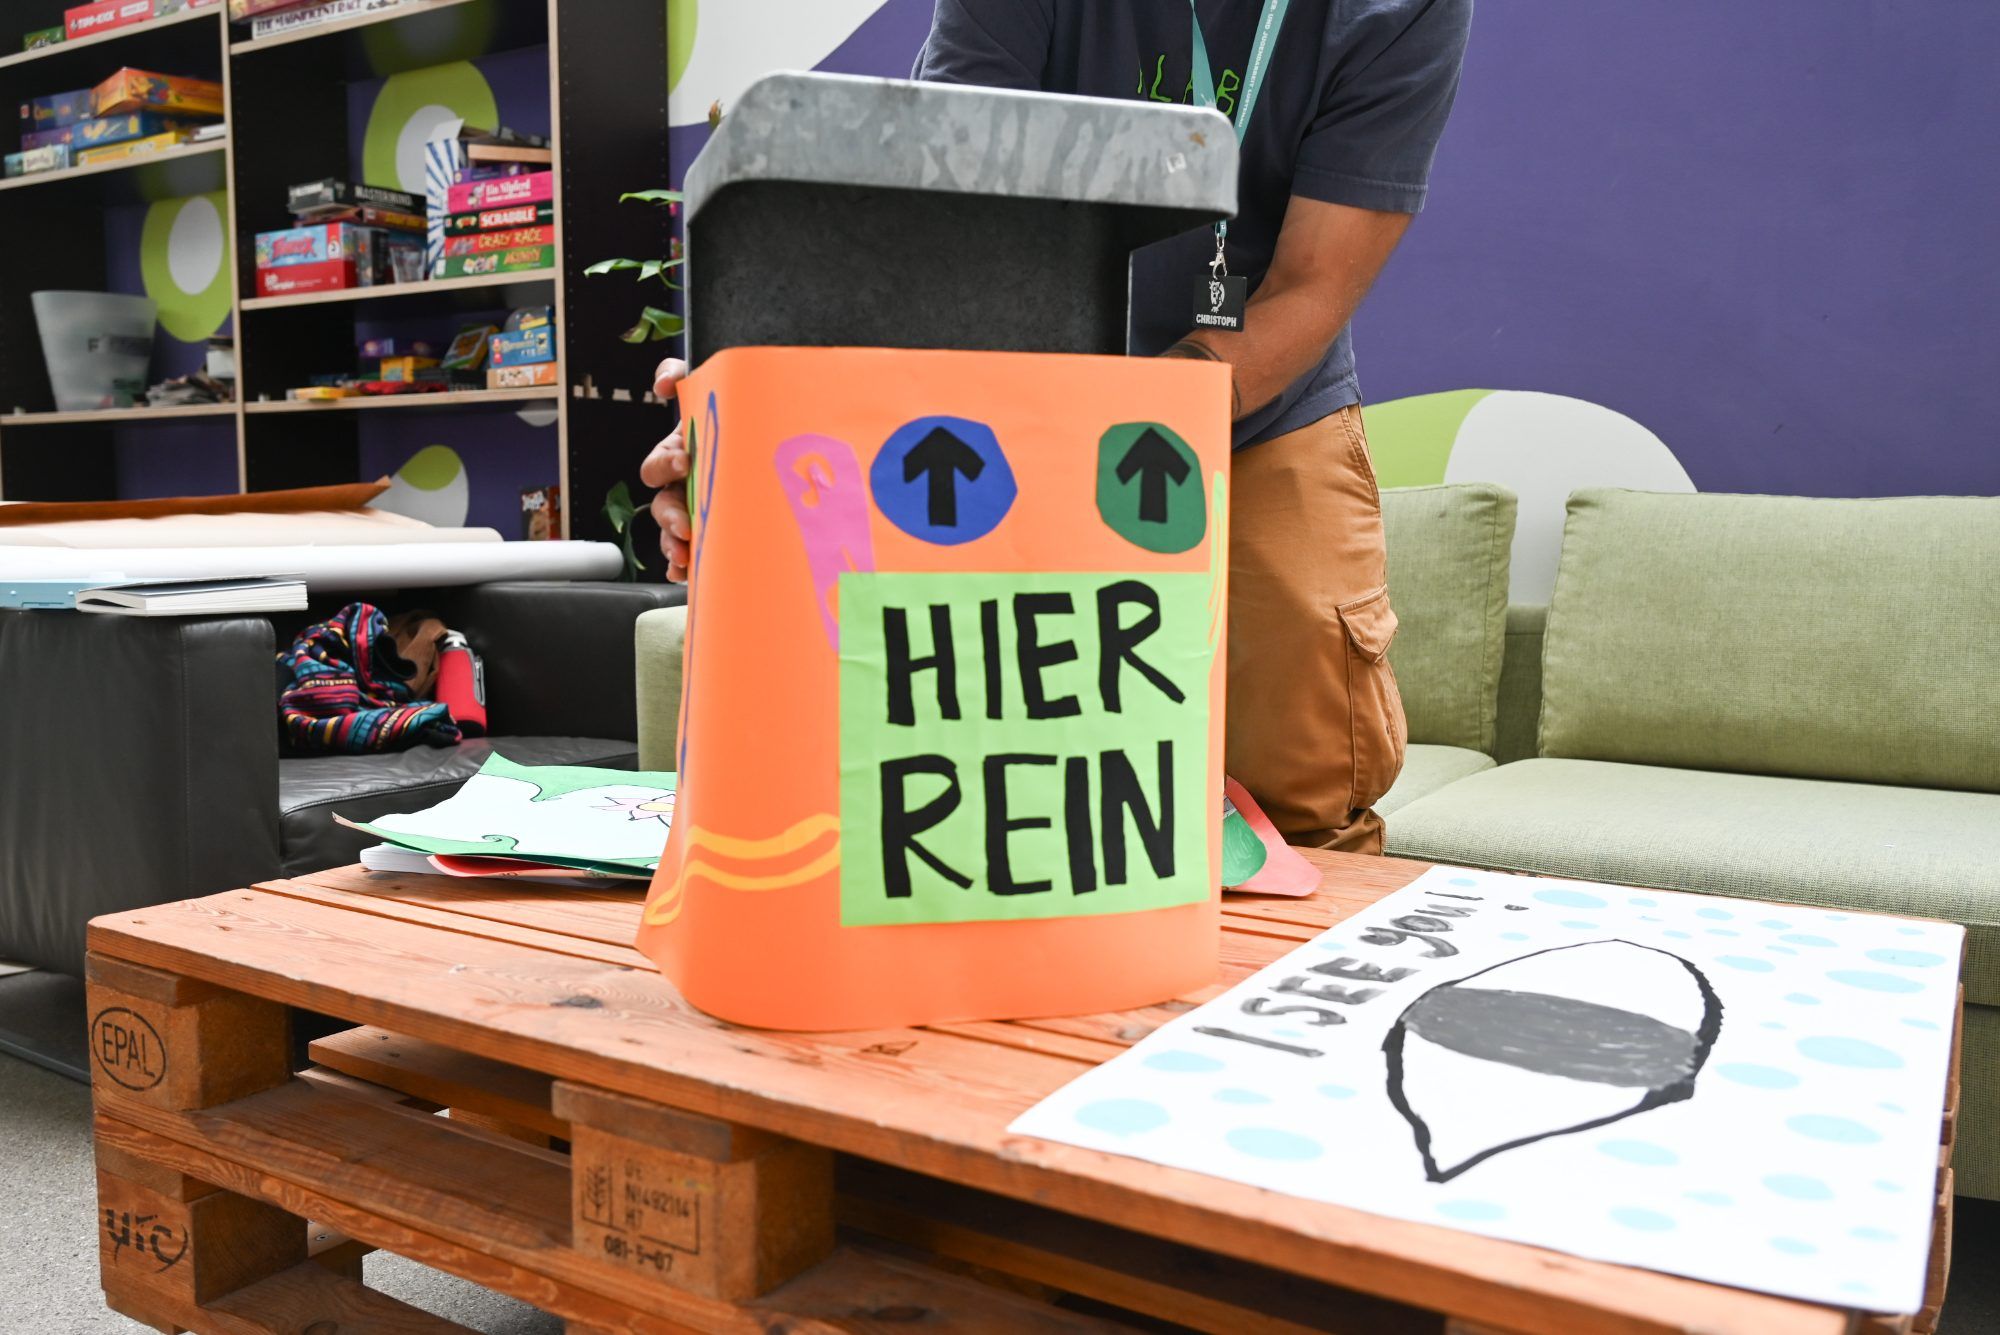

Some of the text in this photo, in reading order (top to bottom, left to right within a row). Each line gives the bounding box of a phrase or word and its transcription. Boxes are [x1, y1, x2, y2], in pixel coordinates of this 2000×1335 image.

[1264, 13, 1274, 29] UND
[355, 186, 413, 205] MASTERMIND
[482, 208, 534, 226] SCRABBLE
[479, 231, 514, 249] CRAZY
[514, 228, 542, 245] RACE
[1195, 313, 1237, 327] CHRISTOPH
[882, 579, 1186, 727] HIER
[880, 740, 1176, 899] REIN
[1240, 956, 1422, 1027] SEE
[101, 1021, 156, 1078] EPAL
[1192, 1025, 1326, 1057] I
